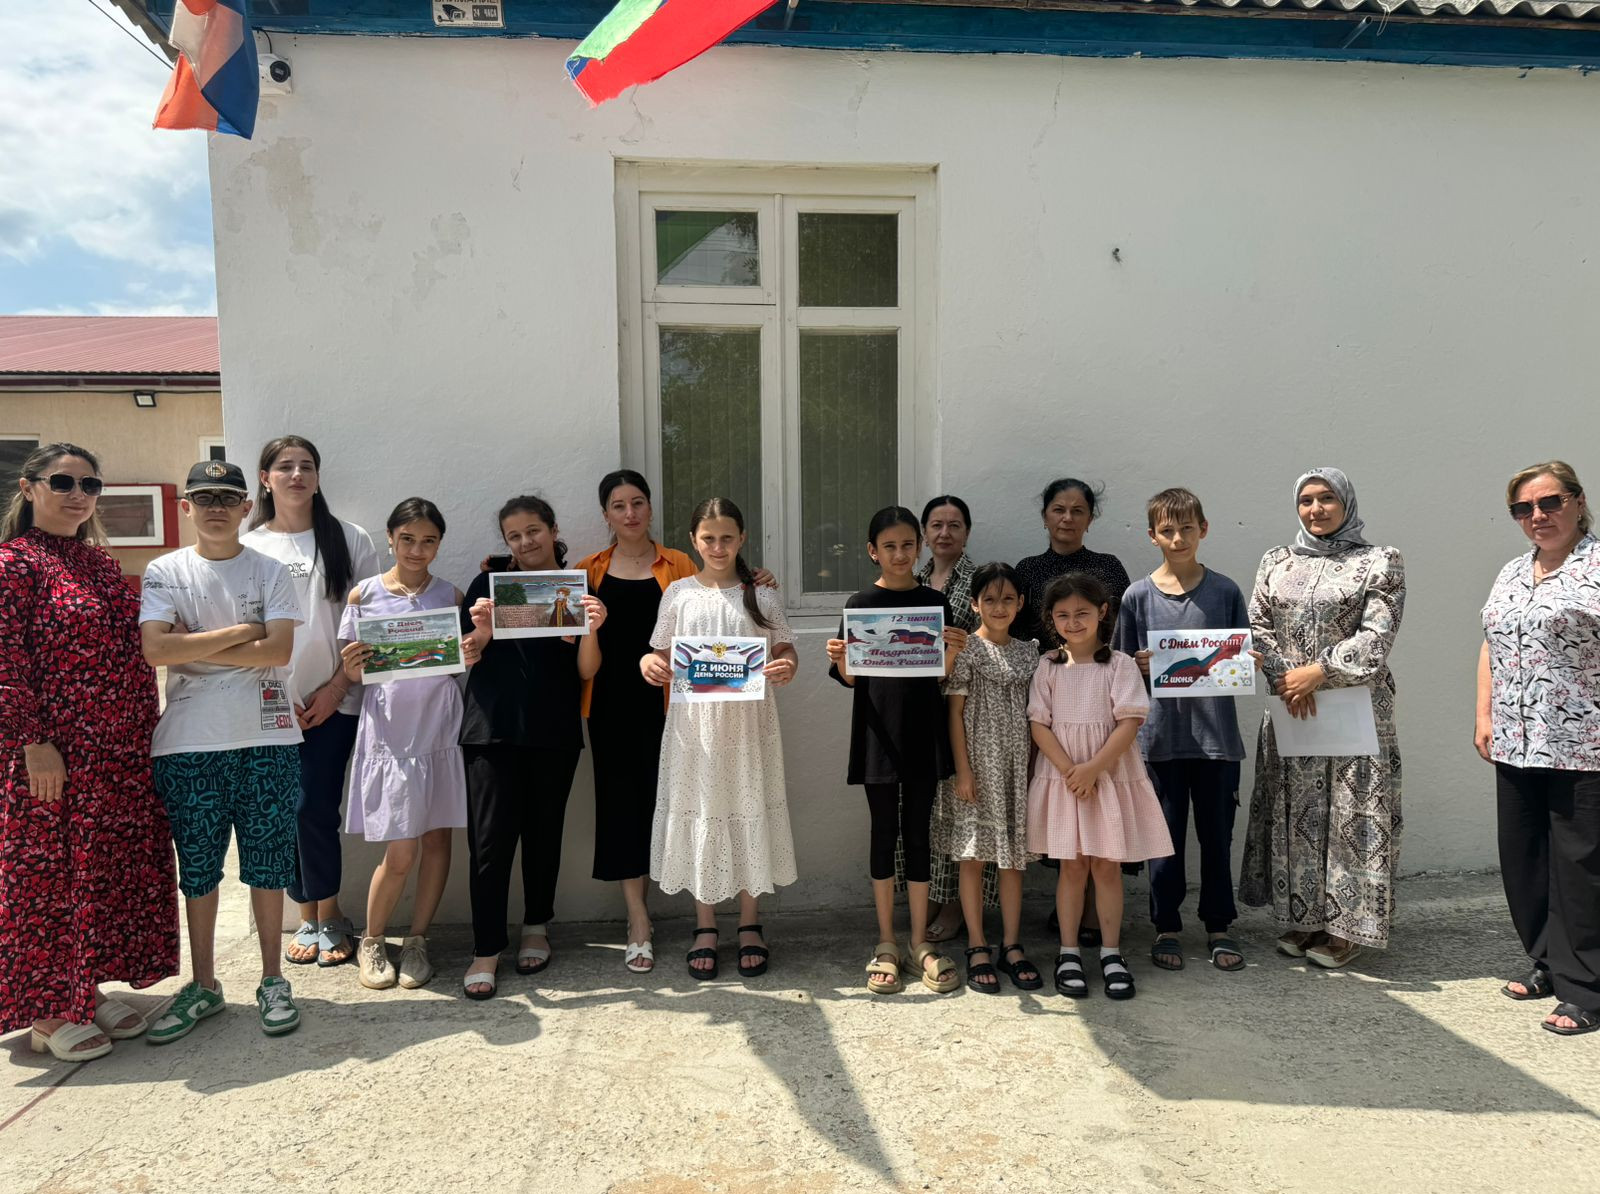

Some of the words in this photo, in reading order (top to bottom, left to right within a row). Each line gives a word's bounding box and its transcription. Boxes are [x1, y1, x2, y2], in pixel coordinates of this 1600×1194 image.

[1168, 638, 1200, 650] Днём
[1200, 636, 1244, 649] России!
[897, 658, 940, 666] России!
[694, 664, 707, 672] 12
[709, 664, 744, 672] ИЮНЯ
[1160, 674, 1169, 683] 12
[1170, 676, 1194, 684] июня
